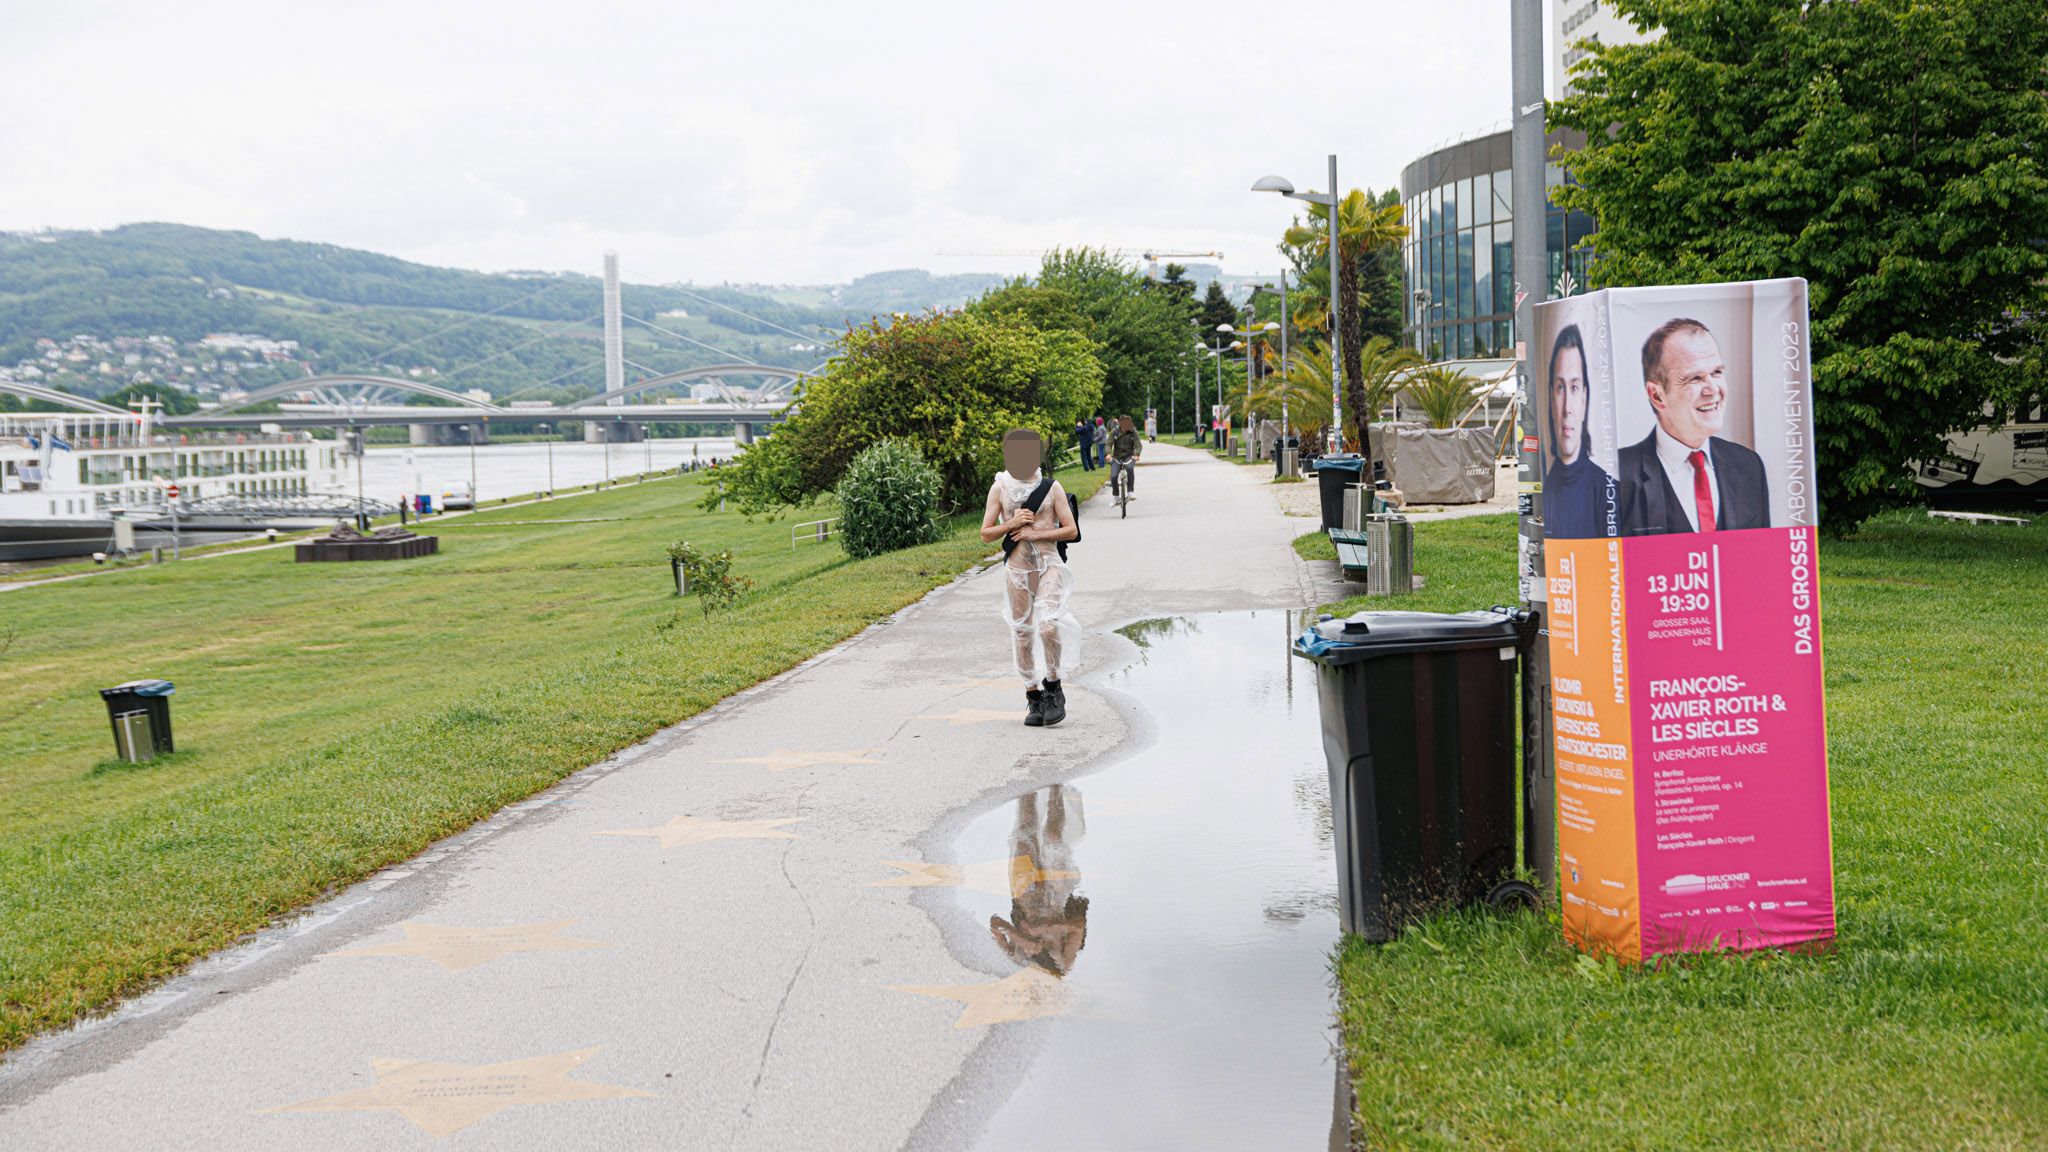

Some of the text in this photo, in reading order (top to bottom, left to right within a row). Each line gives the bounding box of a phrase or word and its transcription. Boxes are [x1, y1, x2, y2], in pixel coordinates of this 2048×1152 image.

[1782, 321, 1812, 655] DAS GROSSE ABONNEMENT 2023
[1598, 305, 1624, 703] INTERNATIONALES BRUCKNERFEST LINZ 2023
[1688, 552, 1707, 569] DI
[1648, 572, 1708, 593] 13 JUN
[1660, 593, 1709, 613] 19:30
[1653, 616, 1710, 628] GROSSER SAAL
[1648, 627, 1711, 639] BRUCKNERHAUS
[1692, 638, 1712, 646] LINZ
[1650, 675, 1746, 698] FRANÇOIS-
[1651, 694, 1787, 720] XAVIER ROTH &
[1652, 717, 1759, 743] LES SIÈCLES
[1653, 742, 1768, 762] UNERHÖRTE KLÄNGE
[1662, 769, 1684, 777] Berlioz
[1657, 834, 1668, 842] Les
[1707, 837, 1724, 845] Roth
[1728, 835, 1755, 845] Dirigent
[1706, 872, 1750, 883] BRUCKNER
